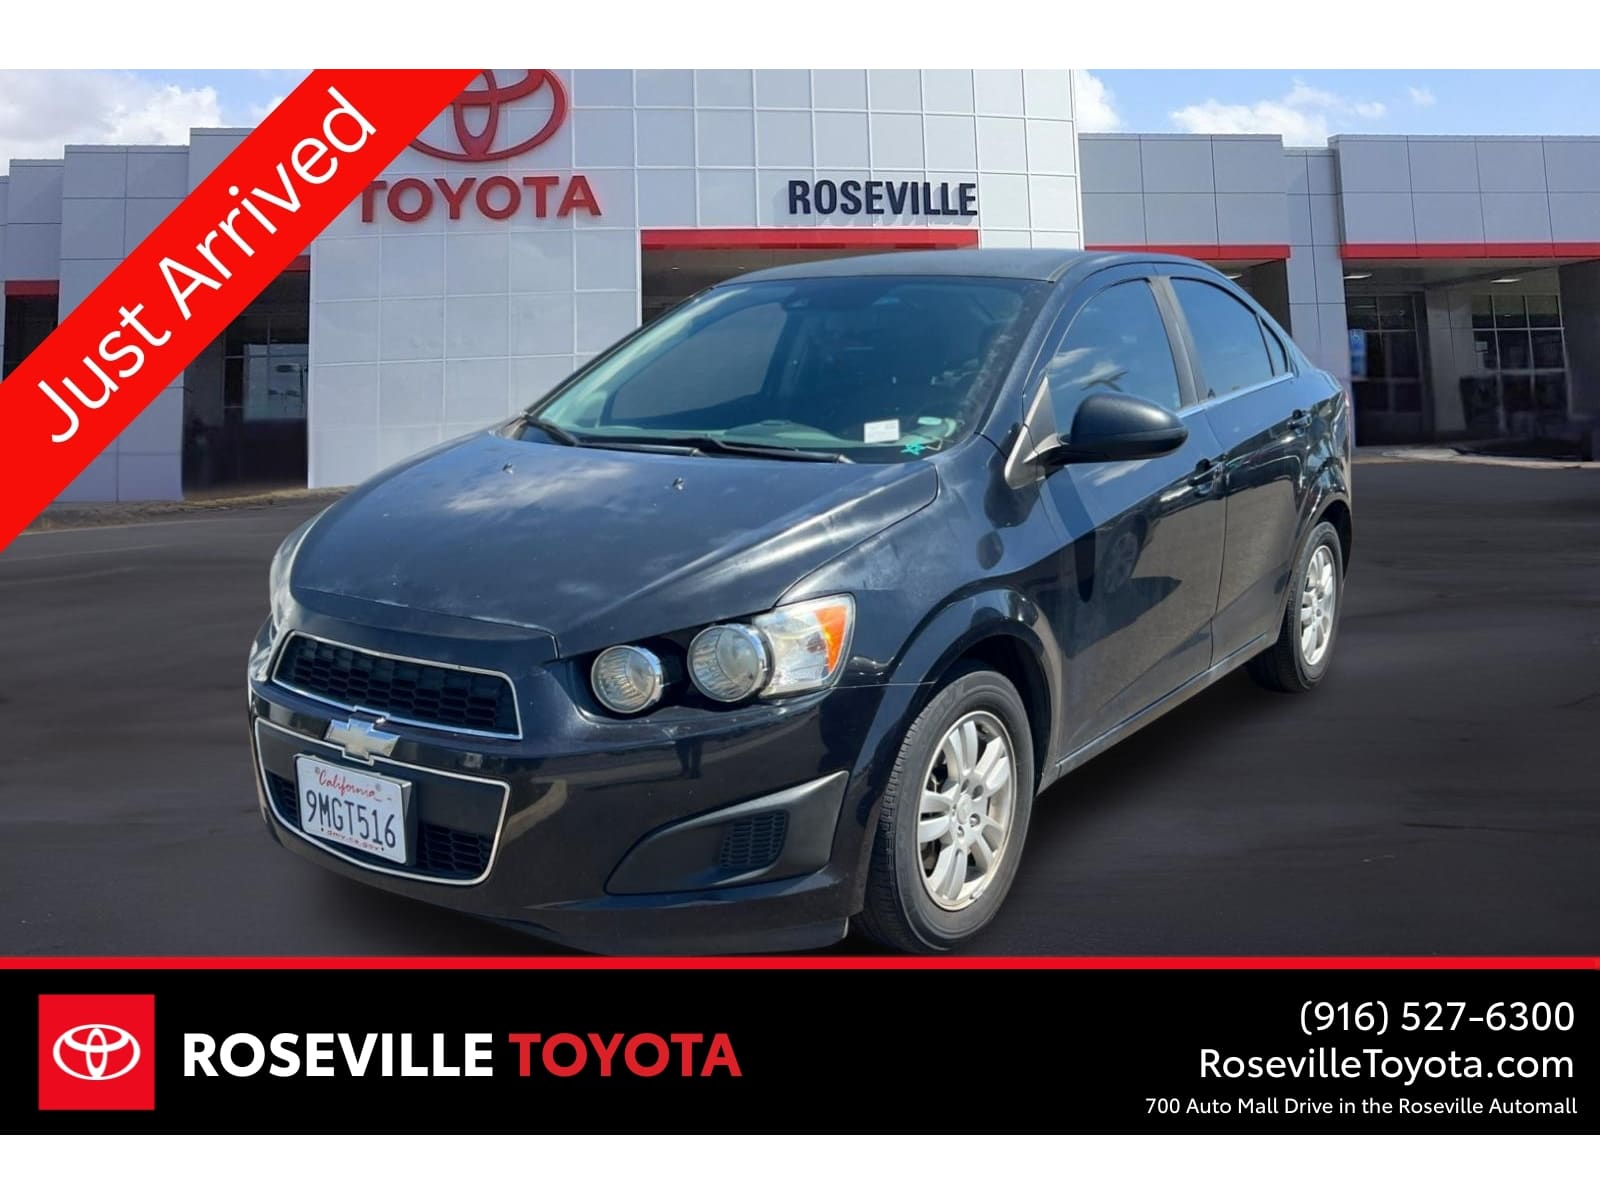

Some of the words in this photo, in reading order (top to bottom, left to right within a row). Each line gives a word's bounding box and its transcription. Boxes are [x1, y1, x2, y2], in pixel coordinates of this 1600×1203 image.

[361, 175, 601, 223] TOYOTA
[788, 180, 978, 217] ROSEVILLE
[318, 767, 377, 798] California
[306, 789, 397, 849] 9MGT516
